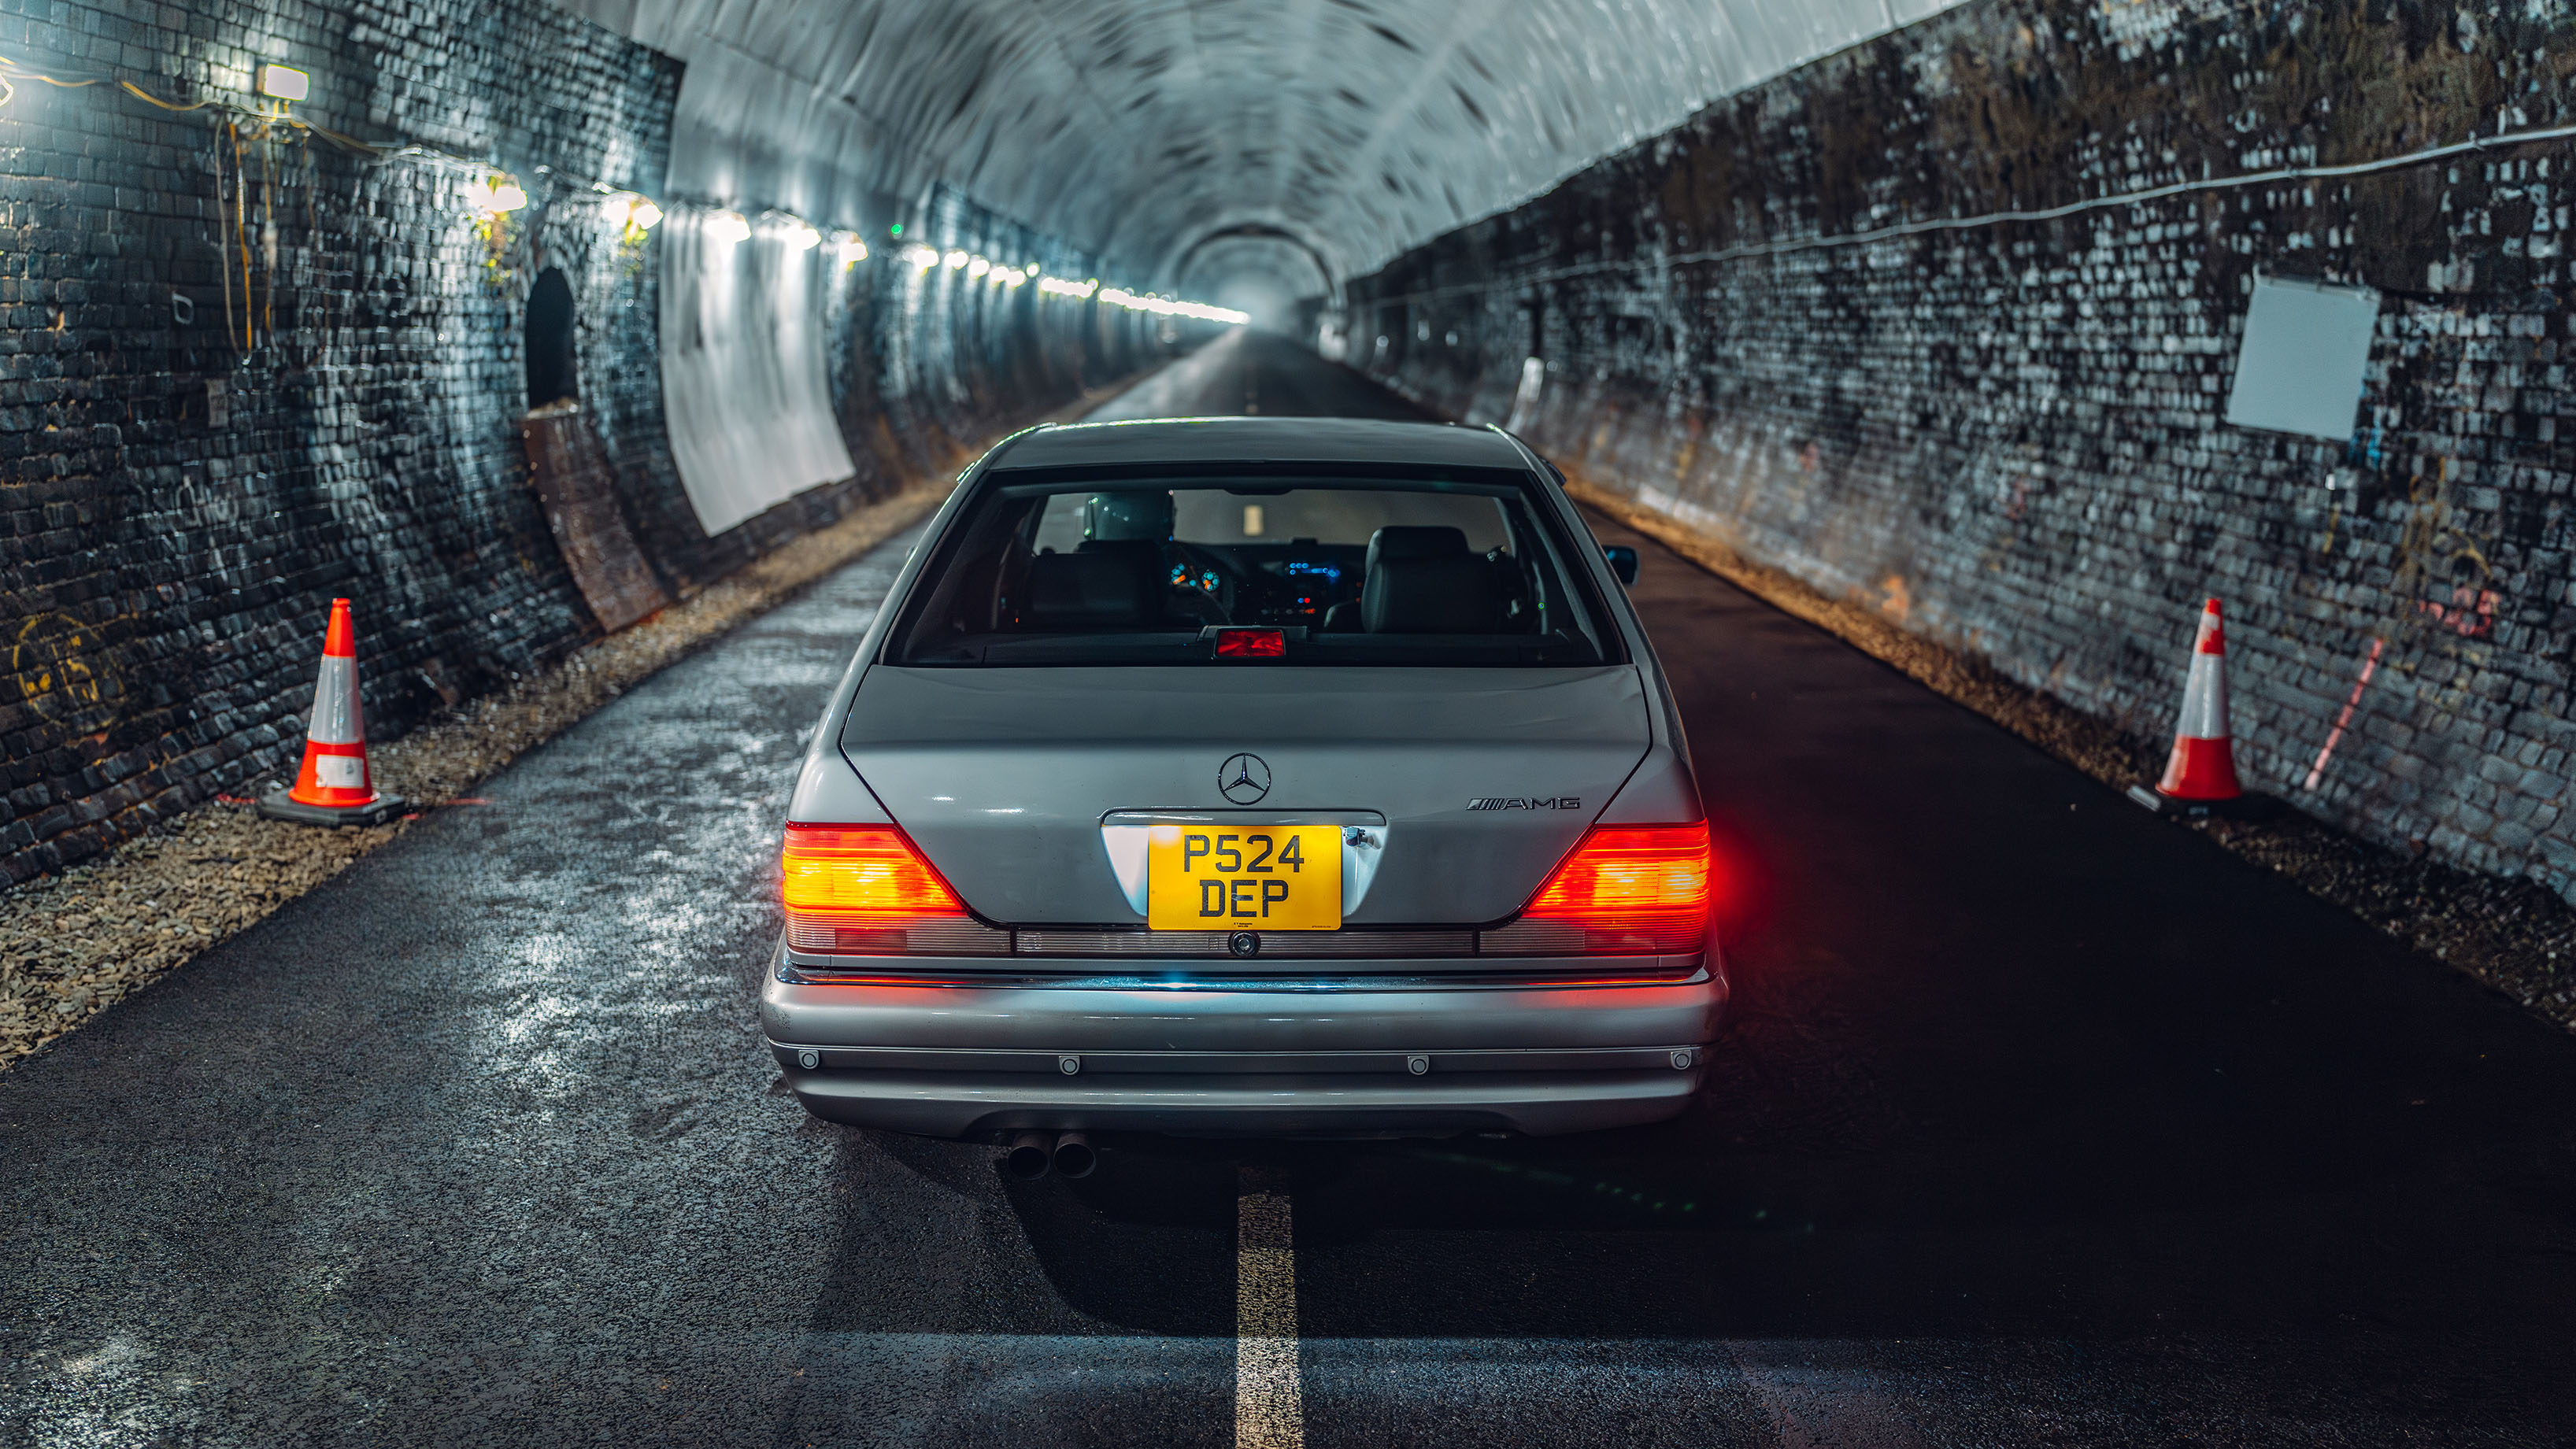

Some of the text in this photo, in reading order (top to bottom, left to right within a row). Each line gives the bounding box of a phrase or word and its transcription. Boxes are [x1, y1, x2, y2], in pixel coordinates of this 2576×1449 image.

[1501, 797, 1580, 810] AMG
[1184, 834, 1305, 873] P524
[1199, 879, 1289, 918] DEP
